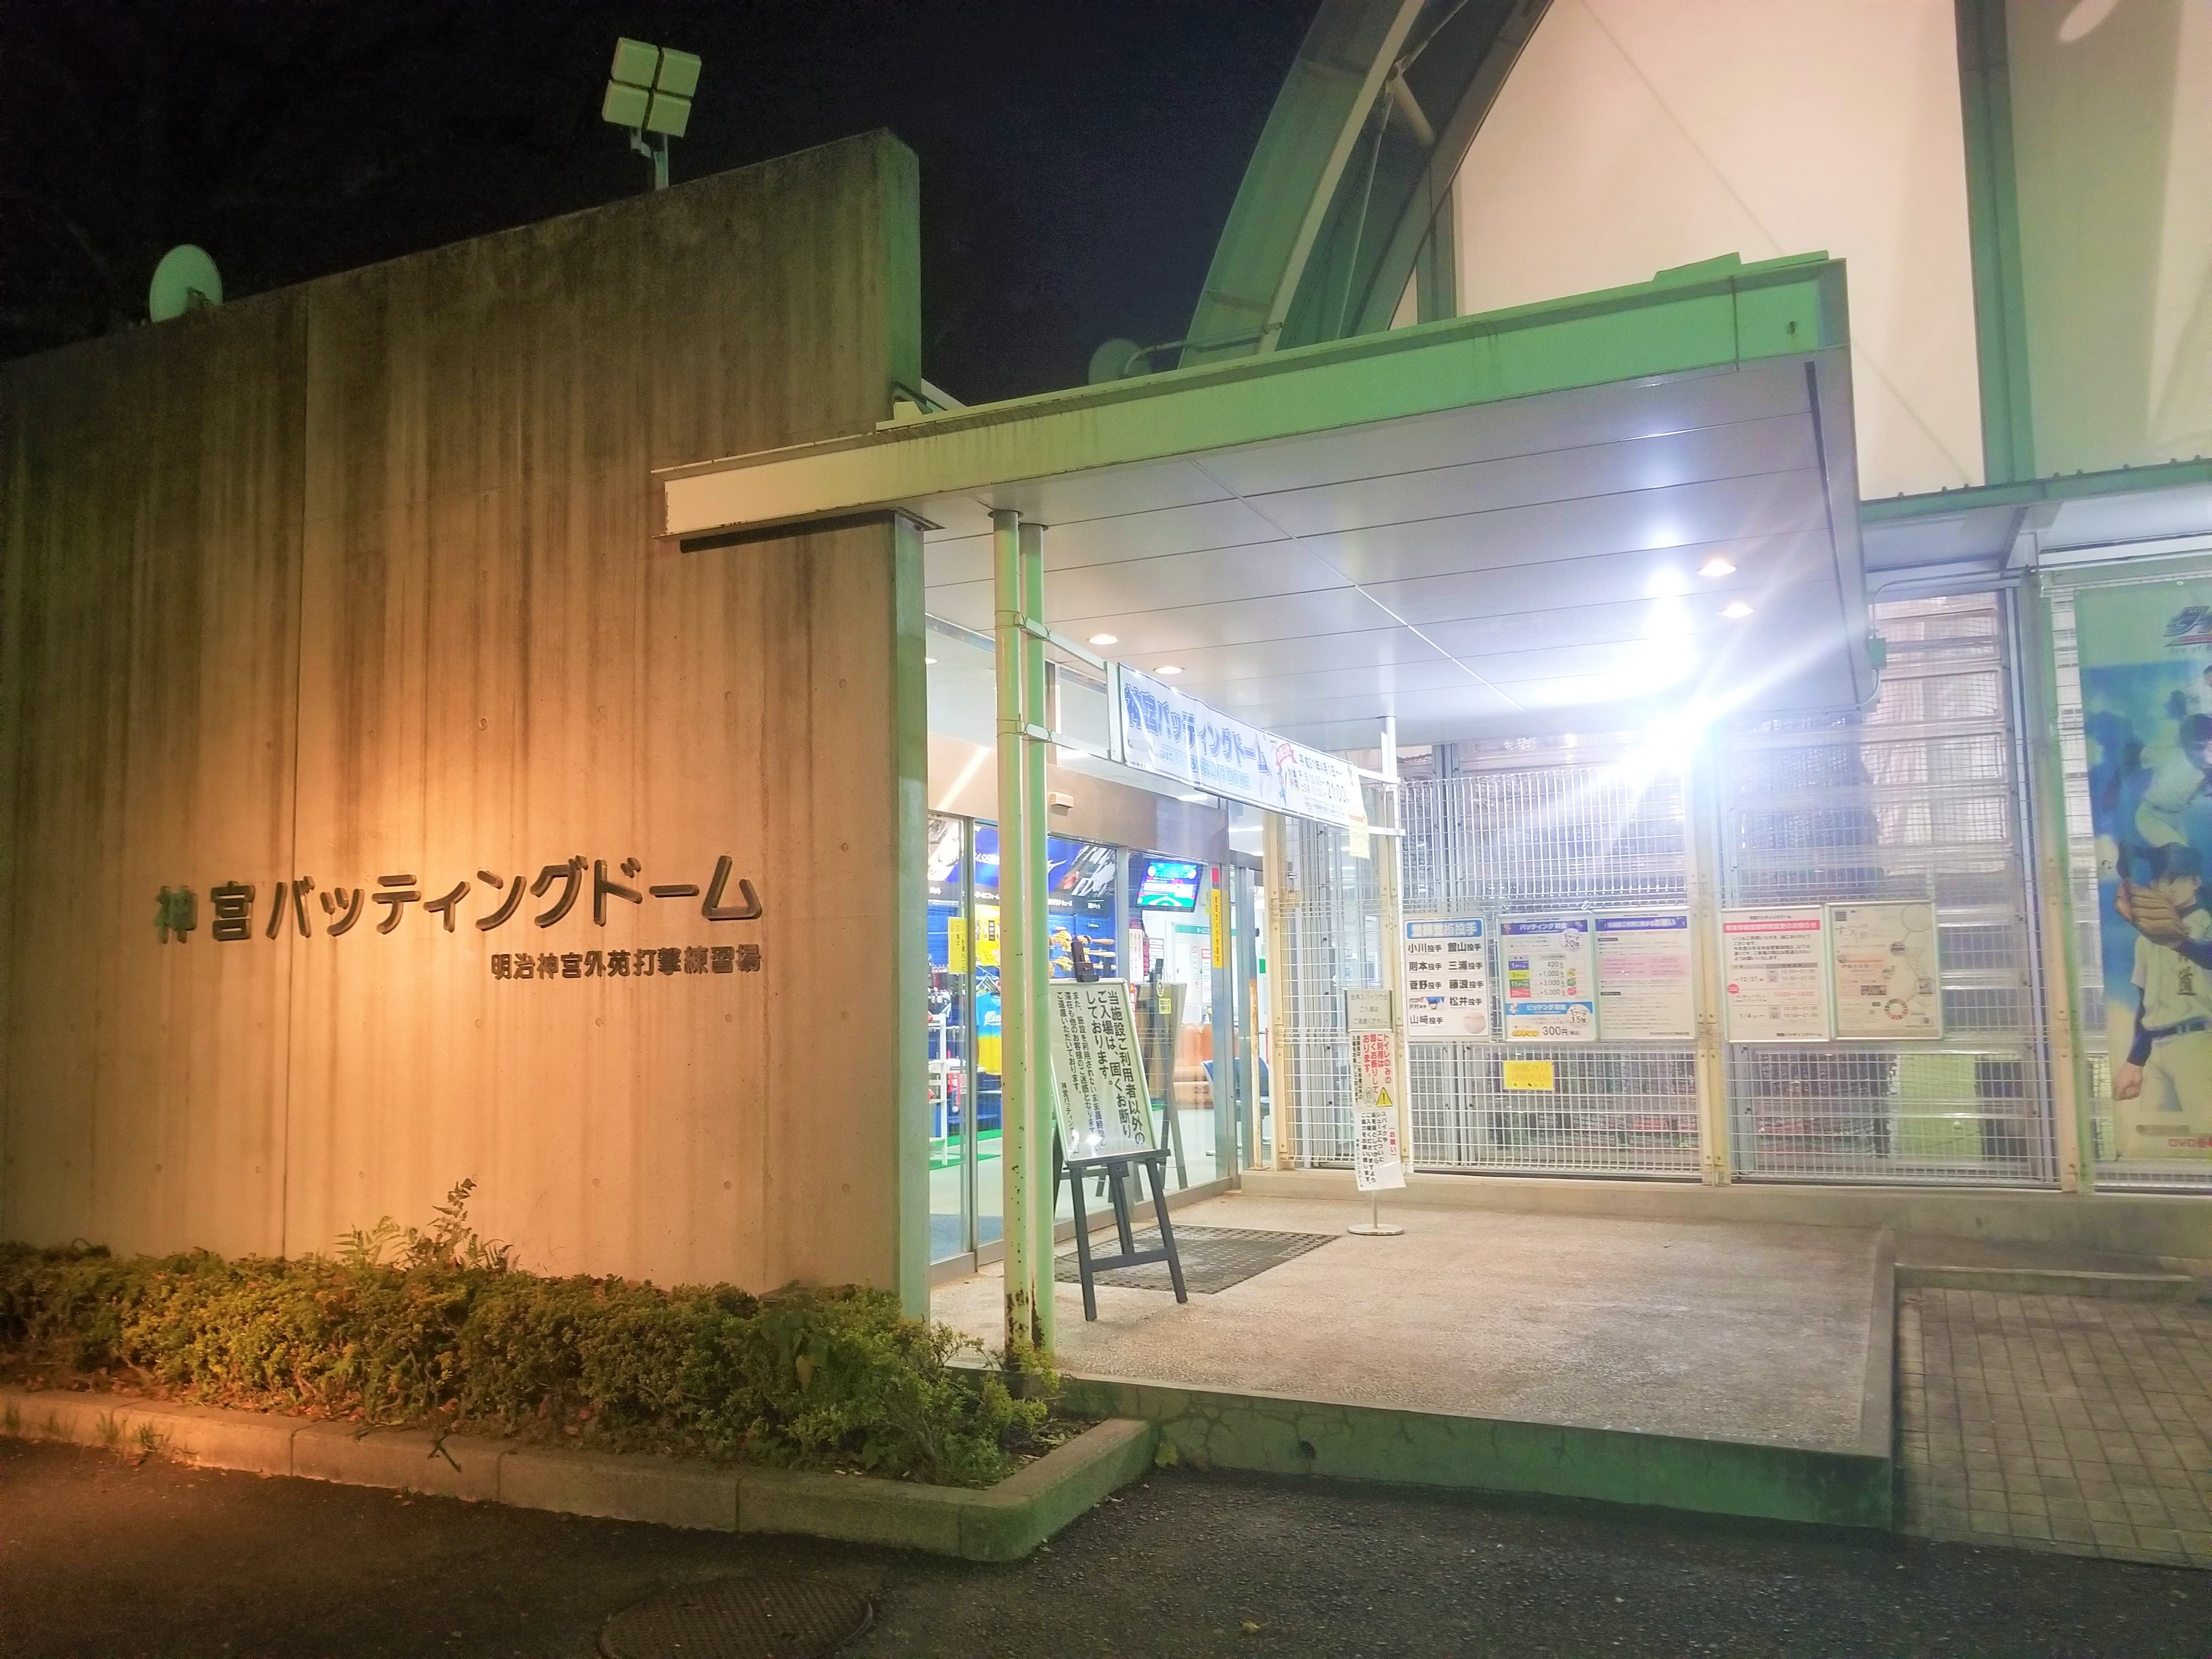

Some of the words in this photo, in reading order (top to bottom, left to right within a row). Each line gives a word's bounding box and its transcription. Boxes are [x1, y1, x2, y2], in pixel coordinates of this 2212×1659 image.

[155, 855, 763, 944] 神宮バッティングドーム
[492, 943, 761, 980] 明治神宮外苑打撃練習場
[1408, 943, 1442, 953] 小川投手
[1448, 961, 1483, 970] 三浦投手
[1449, 996, 1482, 1006] 松井投手
[1086, 991, 1113, 1086] しております。
[1543, 1026, 1568, 1036] 300円
[1098, 990, 1131, 1139] ご入場は、固くお断り
[1108, 990, 1145, 1145] 当施設ご利用者以外の
